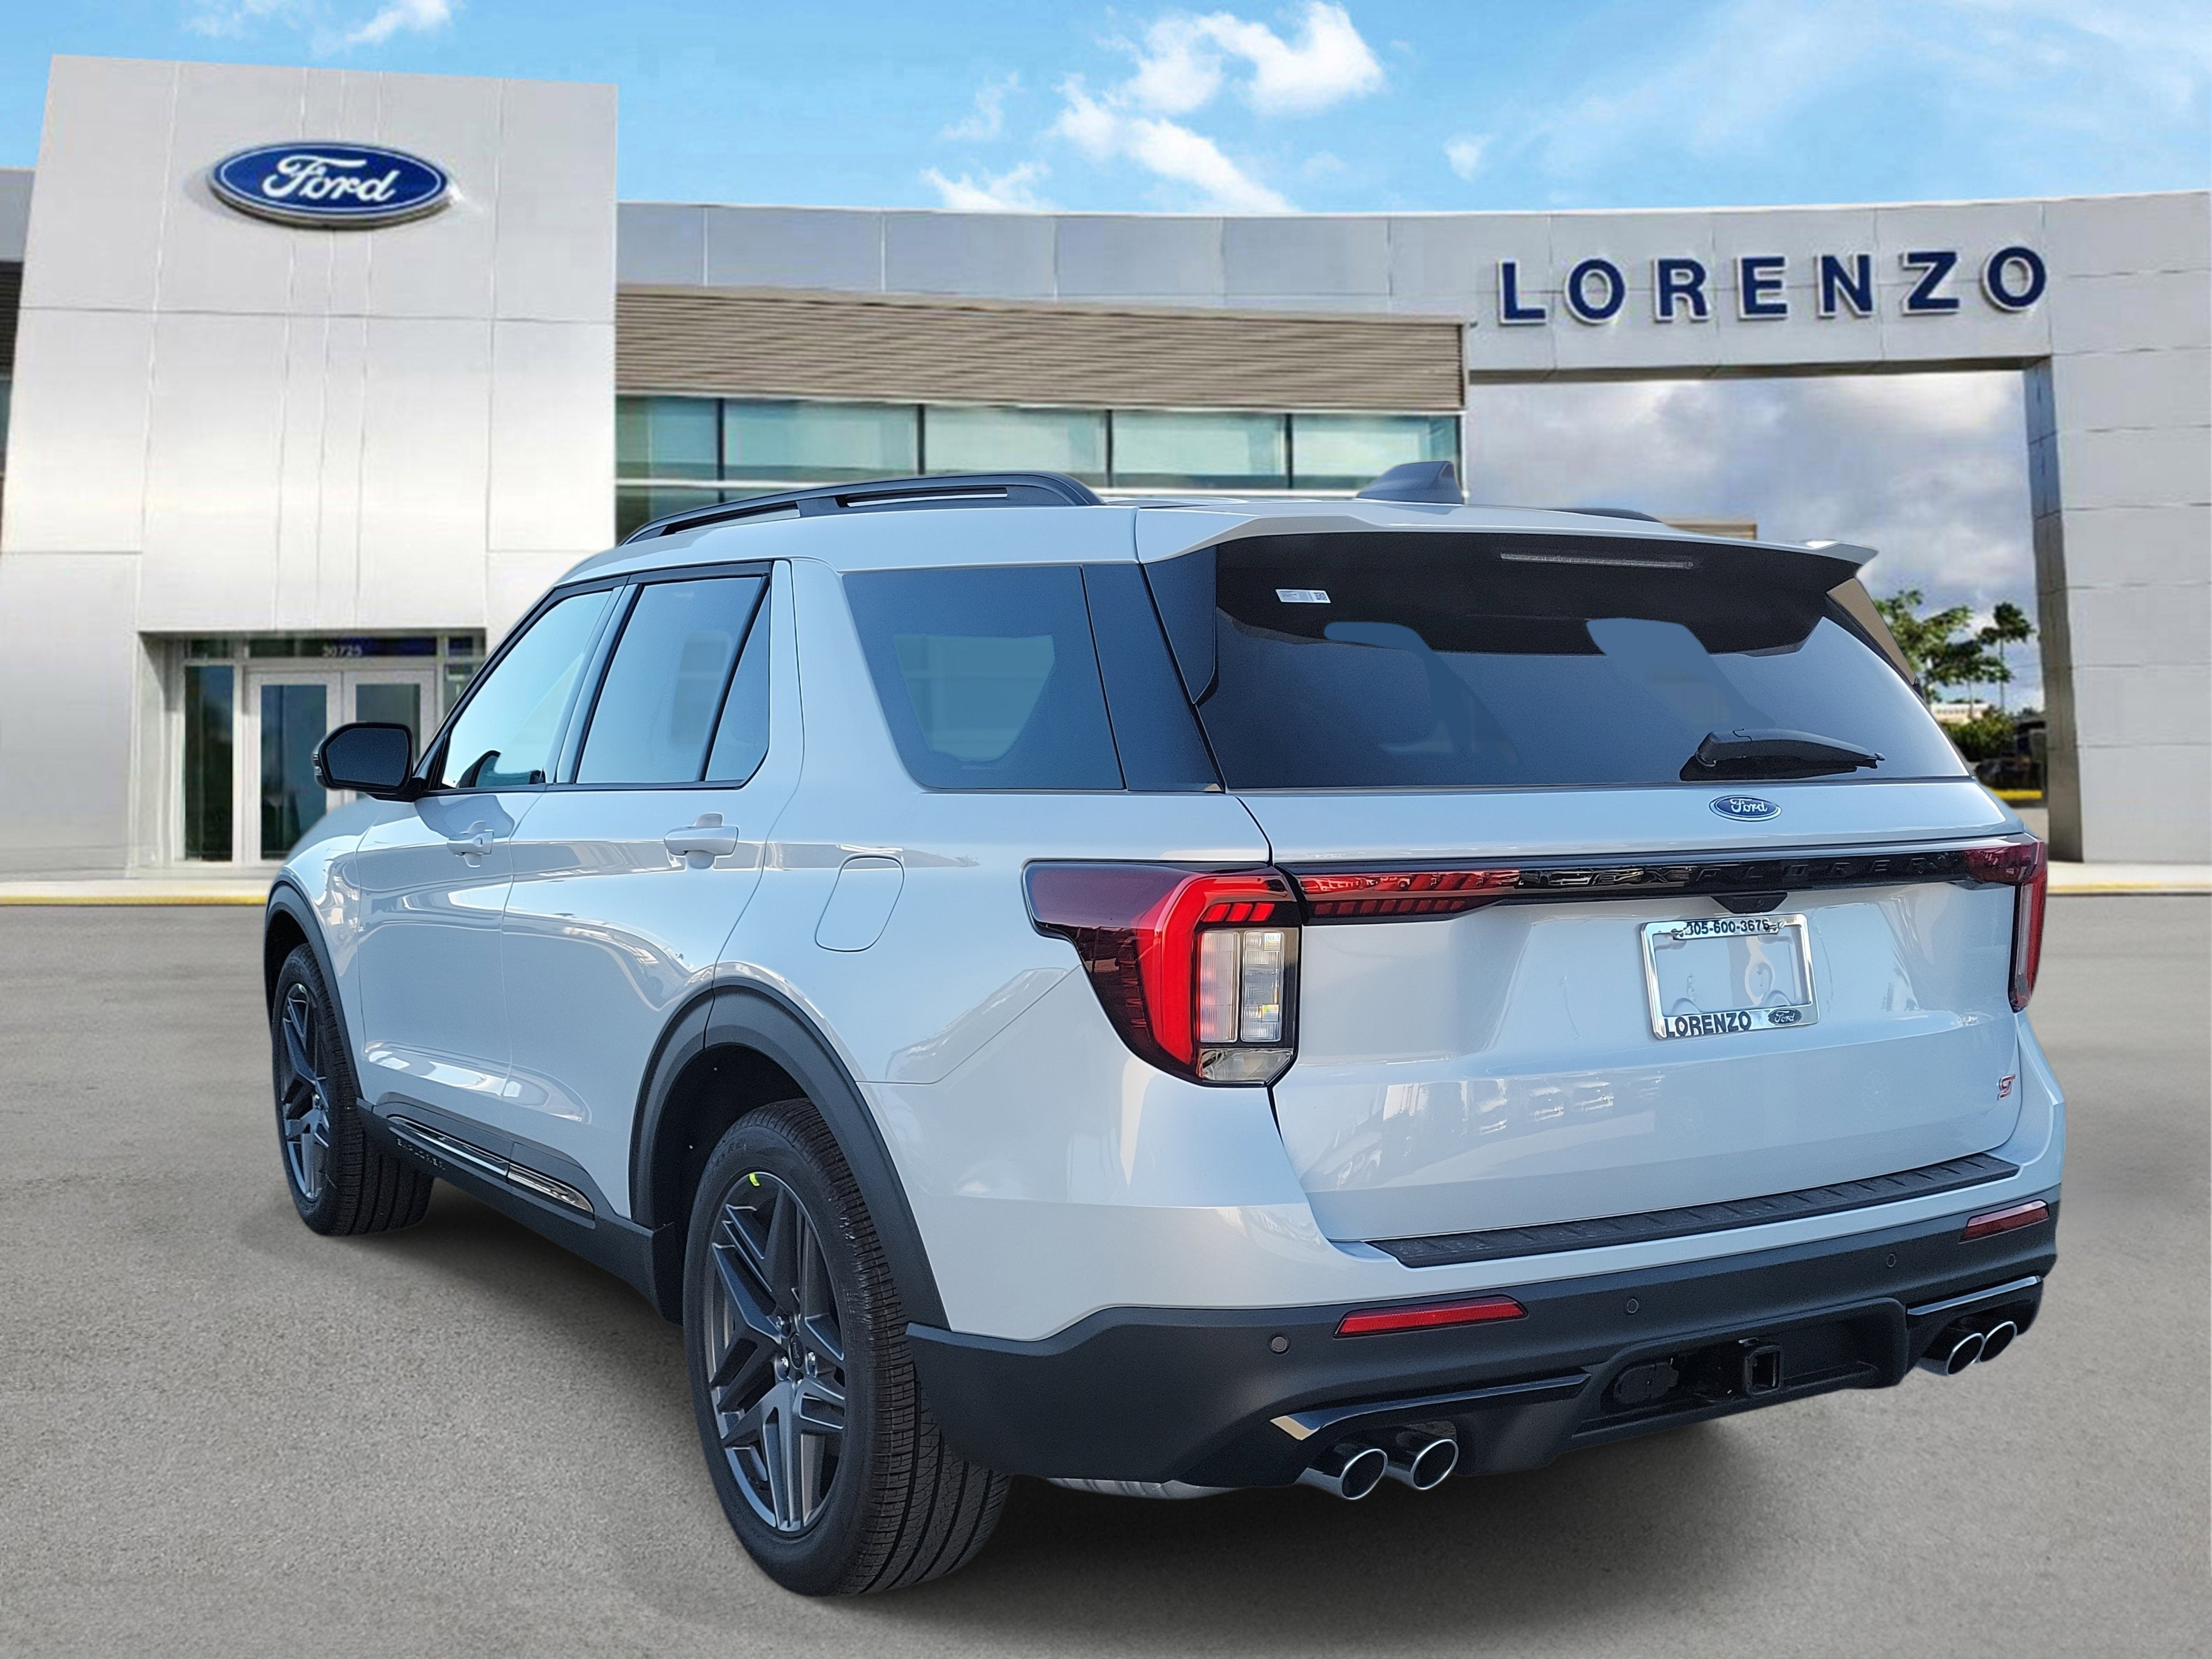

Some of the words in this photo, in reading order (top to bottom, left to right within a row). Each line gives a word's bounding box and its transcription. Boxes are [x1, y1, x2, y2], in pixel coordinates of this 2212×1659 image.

[262, 154, 401, 202] Ford
[1499, 246, 2047, 322] LORENZO
[1729, 798, 1768, 813] Ford
[1664, 1011, 1752, 1038] LORENZO
[1774, 1010, 1795, 1023] Ford
